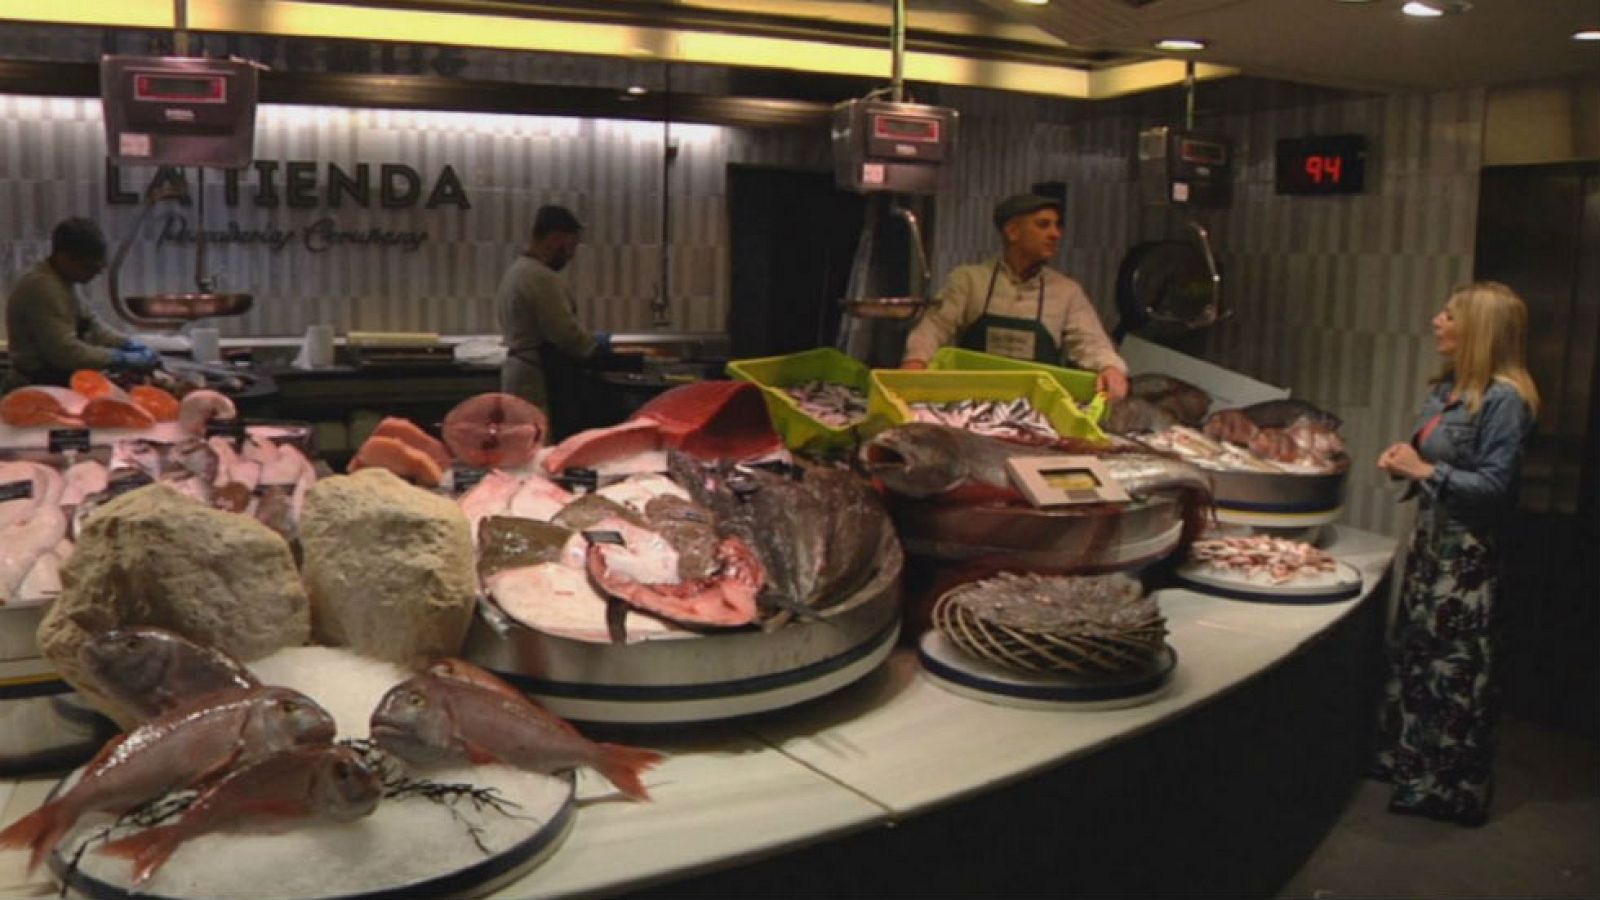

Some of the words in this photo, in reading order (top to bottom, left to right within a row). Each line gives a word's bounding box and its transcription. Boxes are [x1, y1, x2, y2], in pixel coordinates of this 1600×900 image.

[106, 156, 193, 207] LA
[222, 159, 471, 210] TIENDA
[1305, 155, 1342, 183] 94
